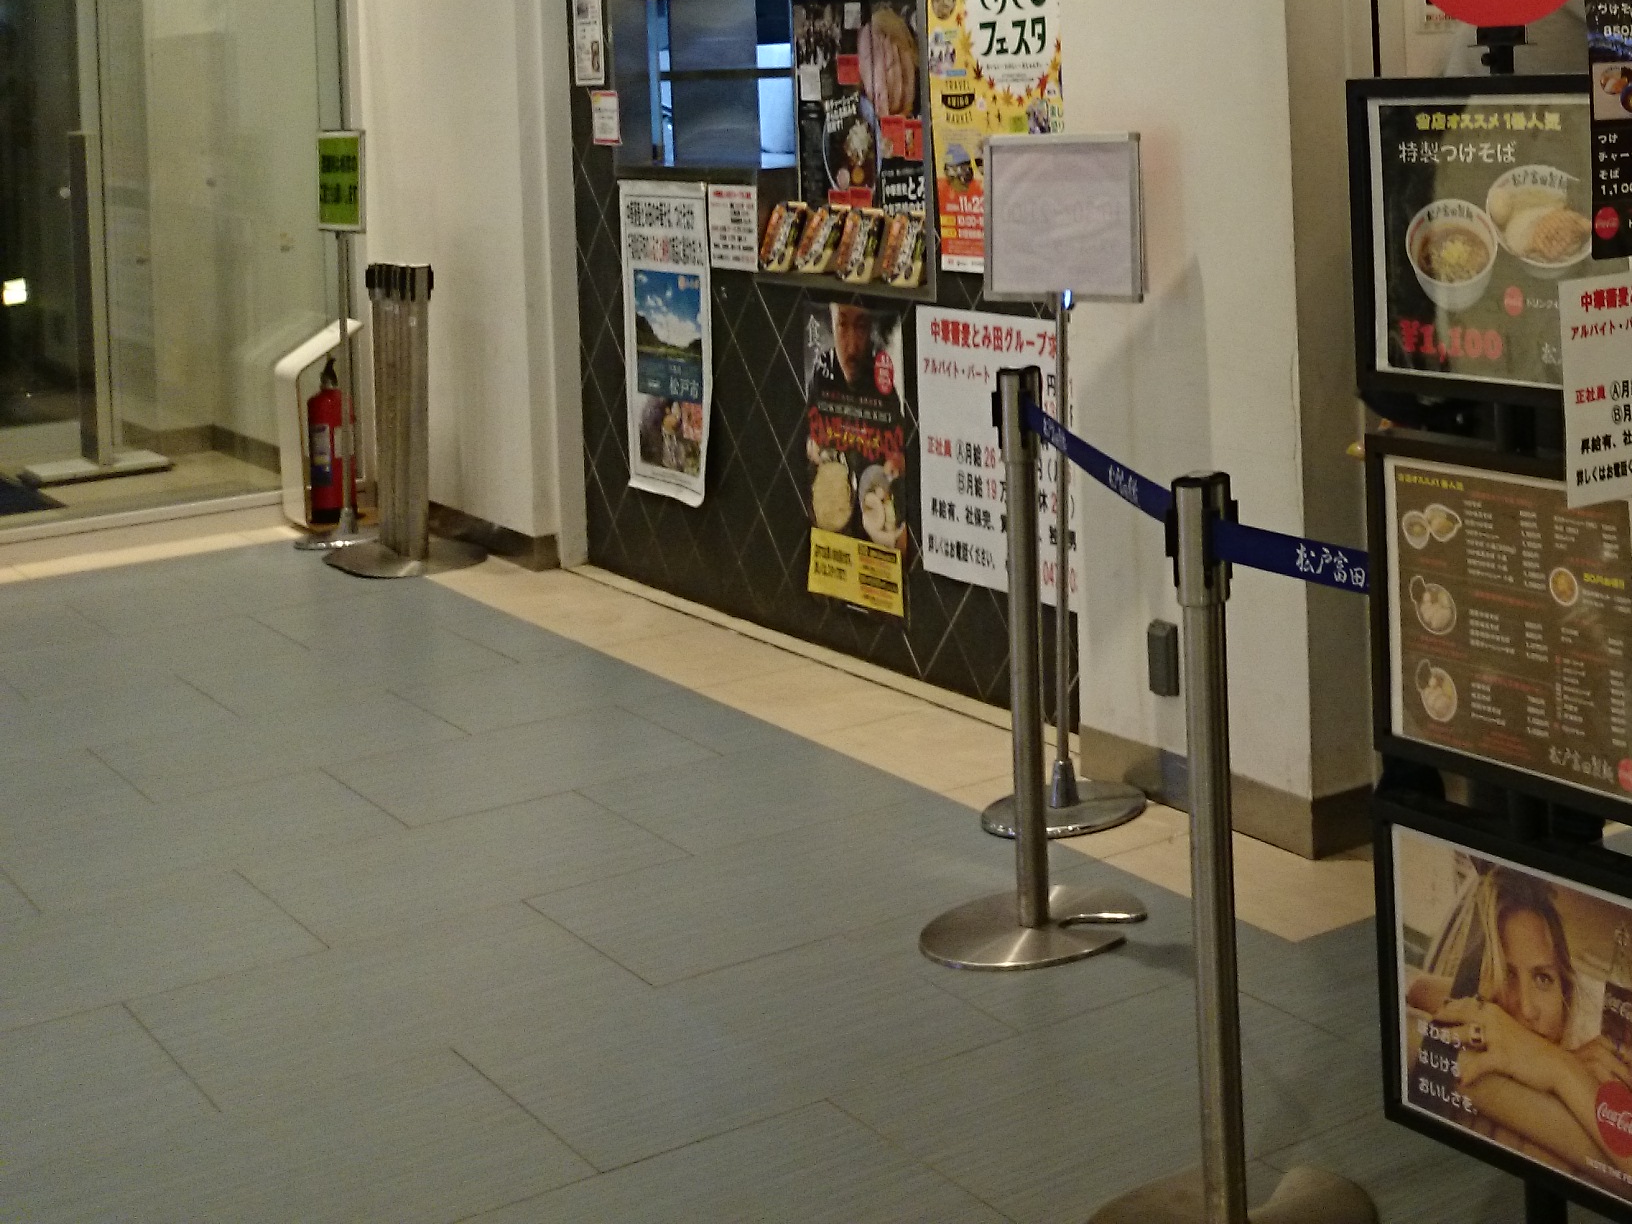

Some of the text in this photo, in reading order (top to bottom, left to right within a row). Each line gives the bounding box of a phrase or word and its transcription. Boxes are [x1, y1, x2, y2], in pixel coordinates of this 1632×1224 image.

[979, 16, 1047, 57] フェスタ
[1398, 140, 1517, 164] 特製つけそば
[1575, 385, 1607, 405] 正社員
[1295, 542, 1368, 589] 松戸富田
[1418, 1049, 1461, 1078] はじける
[1418, 1077, 1478, 1116] おいしさを。
